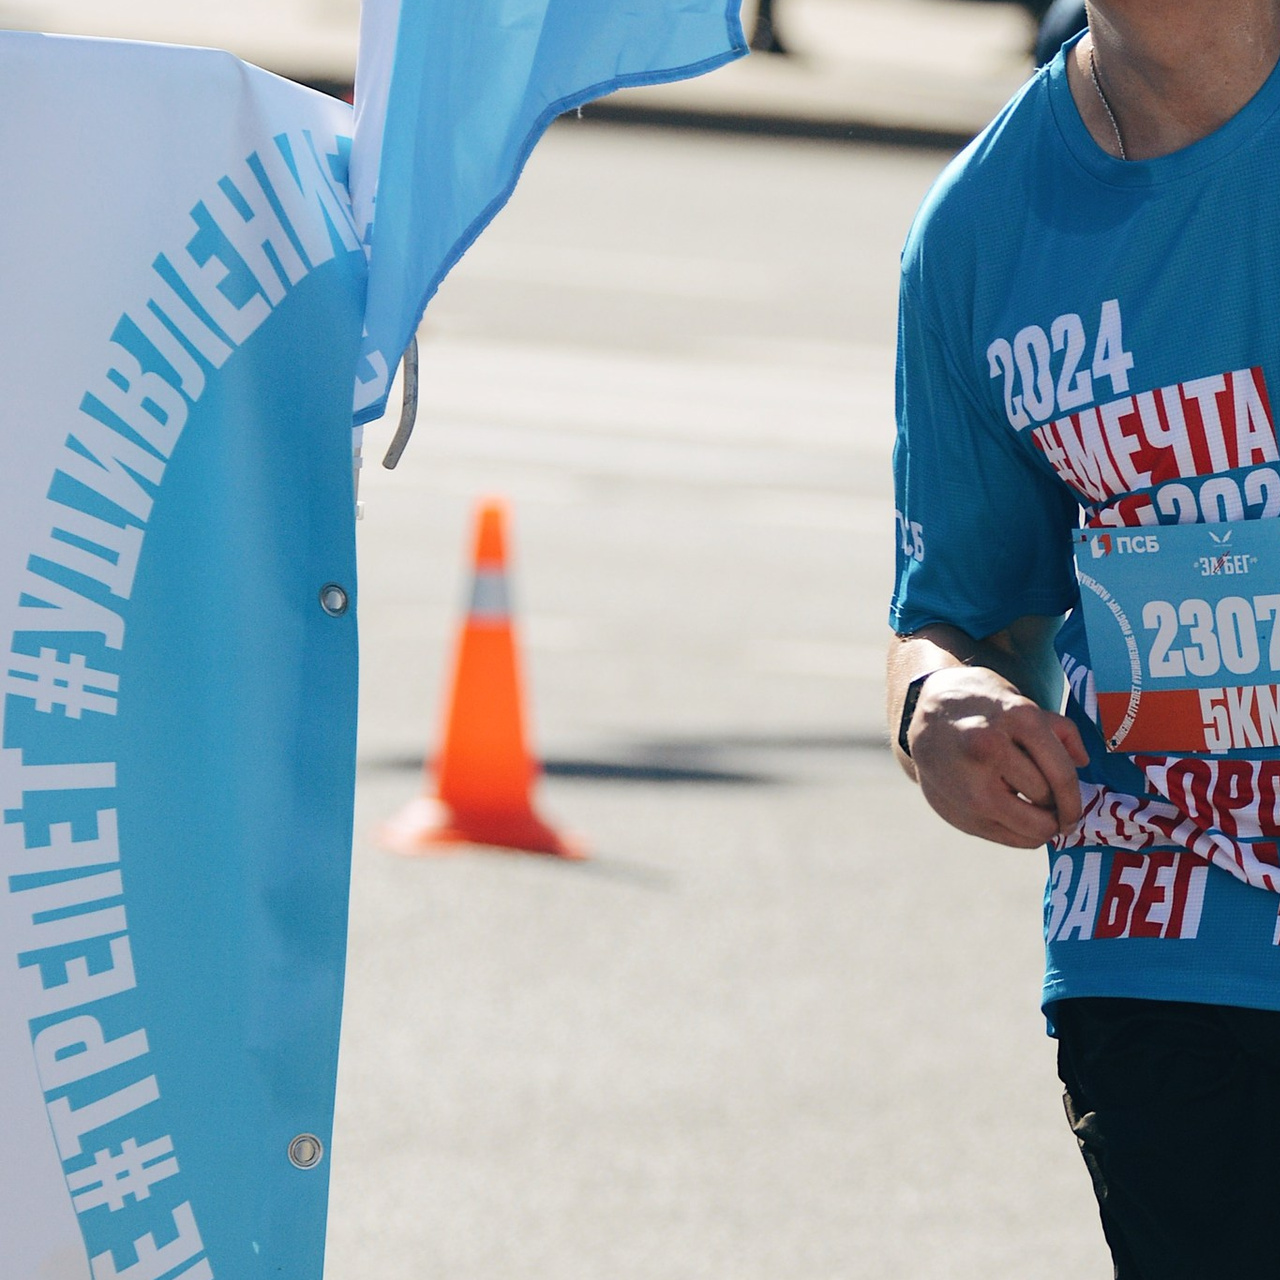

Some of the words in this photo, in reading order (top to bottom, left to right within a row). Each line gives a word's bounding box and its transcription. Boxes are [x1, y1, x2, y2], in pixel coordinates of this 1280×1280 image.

[986, 298, 1135, 432] 2024
[1032, 367, 1280, 504] #МЕЧТА
[1116, 535, 1160, 554] ПСБ
[1047, 851, 1209, 946] ЗАБЕГ
[2, 747, 181, 1212] #ТРЕПЕТ
